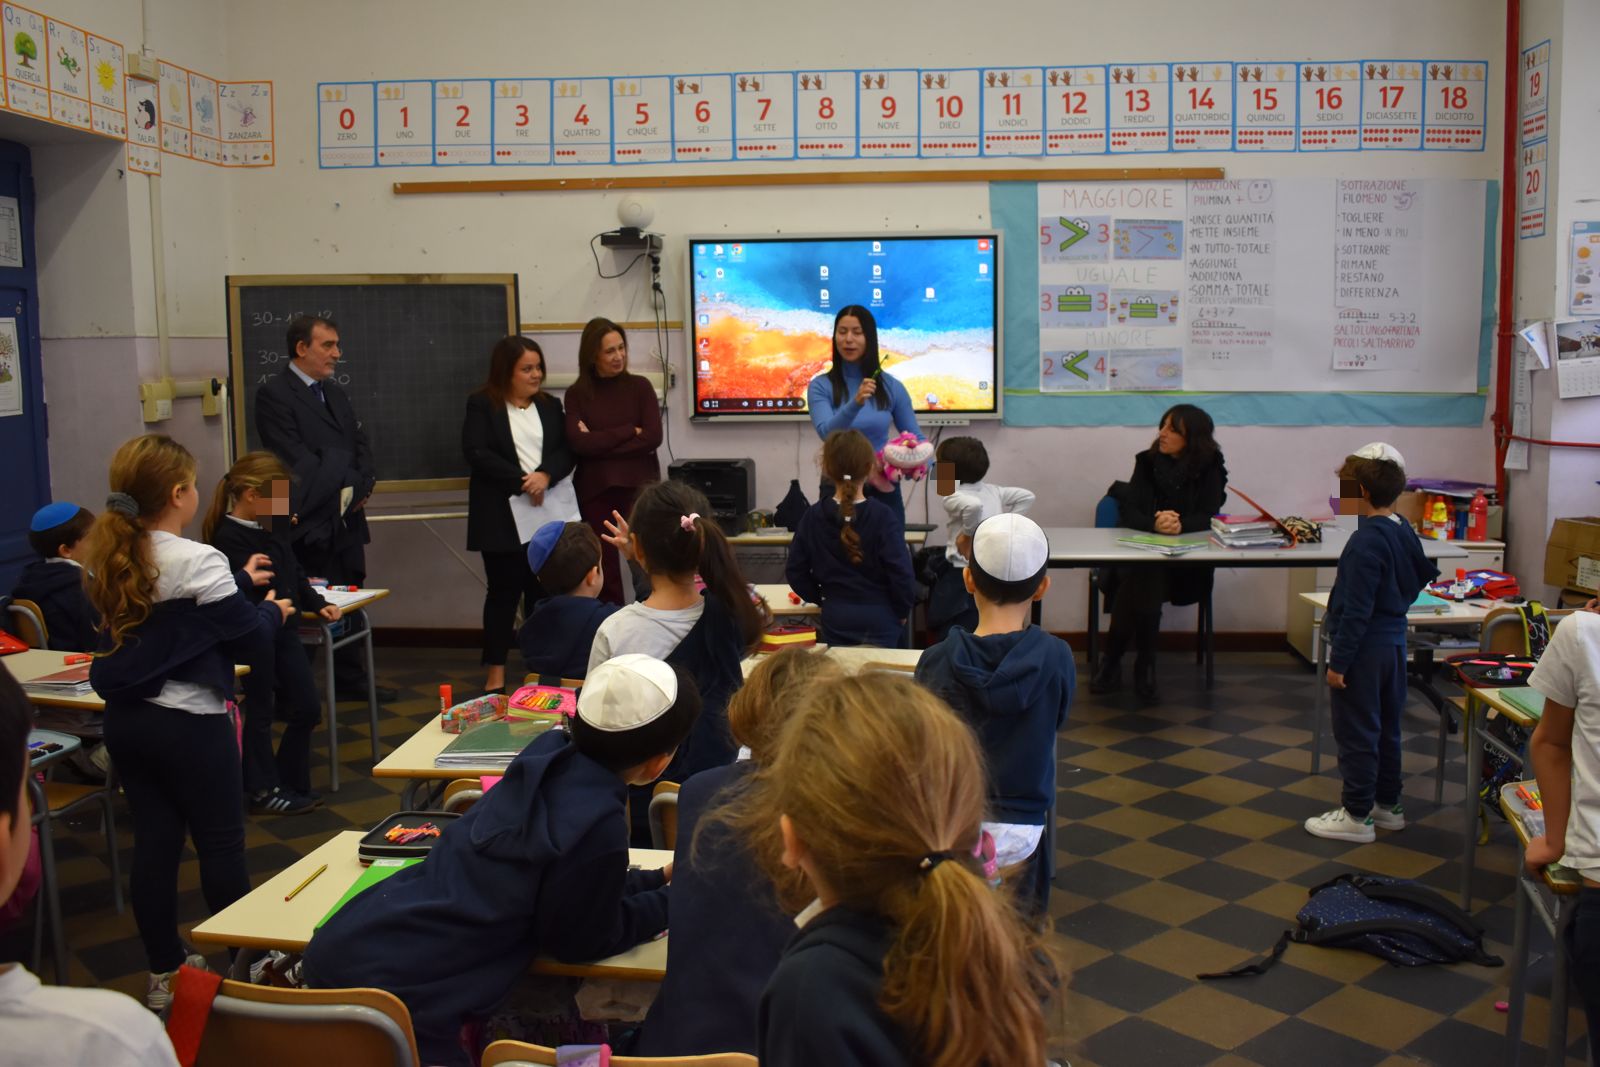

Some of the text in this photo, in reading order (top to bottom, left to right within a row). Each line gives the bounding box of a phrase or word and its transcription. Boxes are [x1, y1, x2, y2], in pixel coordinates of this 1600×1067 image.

[16, 68, 41, 83] QUERCIA
[63, 82, 78, 94] RANA
[1529, 72, 1541, 98] 19
[102, 95, 115, 107] SOLE
[1062, 92, 1087, 114] 12
[1125, 89, 1151, 112] 13
[1188, 88, 1215, 110] 14
[1252, 88, 1278, 110] 15
[1315, 87, 1343, 110] 16
[1379, 86, 1405, 109] 17
[1441, 87, 1468, 109] 18
[757, 99, 772, 121] 7
[818, 97, 834, 119] 8
[881, 96, 897, 119] 9
[936, 95, 964, 118] 10
[1002, 93, 1021, 116] 11
[400, 106, 409, 128] 1
[456, 105, 471, 127] 2
[515, 104, 529, 127] 3
[574, 104, 589, 126] 4
[635, 102, 649, 124] 5
[695, 100, 711, 123] 6
[1316, 113, 1343, 121] SEDICI
[1366, 111, 1417, 121] DICIASSETTE
[1435, 112, 1474, 121] DICIOTTO
[338, 107, 356, 130] 0
[998, 118, 1028, 127] UNDICI
[1061, 117, 1091, 126] DODICI
[1123, 114, 1155, 124] TREDICI
[1175, 113, 1230, 122] QUATTORDICI
[1247, 113, 1285, 122] QUINDICI
[697, 126, 710, 134] SEI
[753, 123, 776, 132] SETTE
[816, 122, 837, 130] OTTO
[878, 121, 900, 130] NOVE
[939, 121, 961, 129] DIECI
[228, 131, 263, 140] ZANZARA
[337, 132, 357, 141] ZERO
[396, 130, 414, 139] UNO
[455, 130, 471, 138] DUE
[516, 129, 529, 137] TRE
[563, 129, 600, 137] QUATTRO
[627, 127, 658, 137] CINQUE
[137, 133, 157, 144] TALPA
[1192, 180, 1241, 191] ADDIZIONE
[1341, 180, 1407, 191] SOTTRAZIONE
[1526, 169, 1540, 195] 20
[1062, 188, 1173, 209] MAGGIORE
[1343, 193, 1387, 204] FILOMENO
[1341, 212, 1384, 223] TOGLIERE
[1040, 224, 1110, 245] 5 3
[1223, 227, 1260, 237] INSIEME
[1343, 227, 1353, 237] IN
[1355, 227, 1380, 237] MENO
[1341, 244, 1391, 255] SOTTRARRE
[1340, 259, 1377, 270] RIMANE
[1077, 267, 1158, 284] UGUALE
[1340, 272, 1384, 283] RESTANO
[1340, 287, 1400, 298] DIFFERENZA
[1041, 292, 1108, 312] 3 3
[1086, 329, 1155, 346] MINORE
[1043, 356, 1106, 376] 2 4
